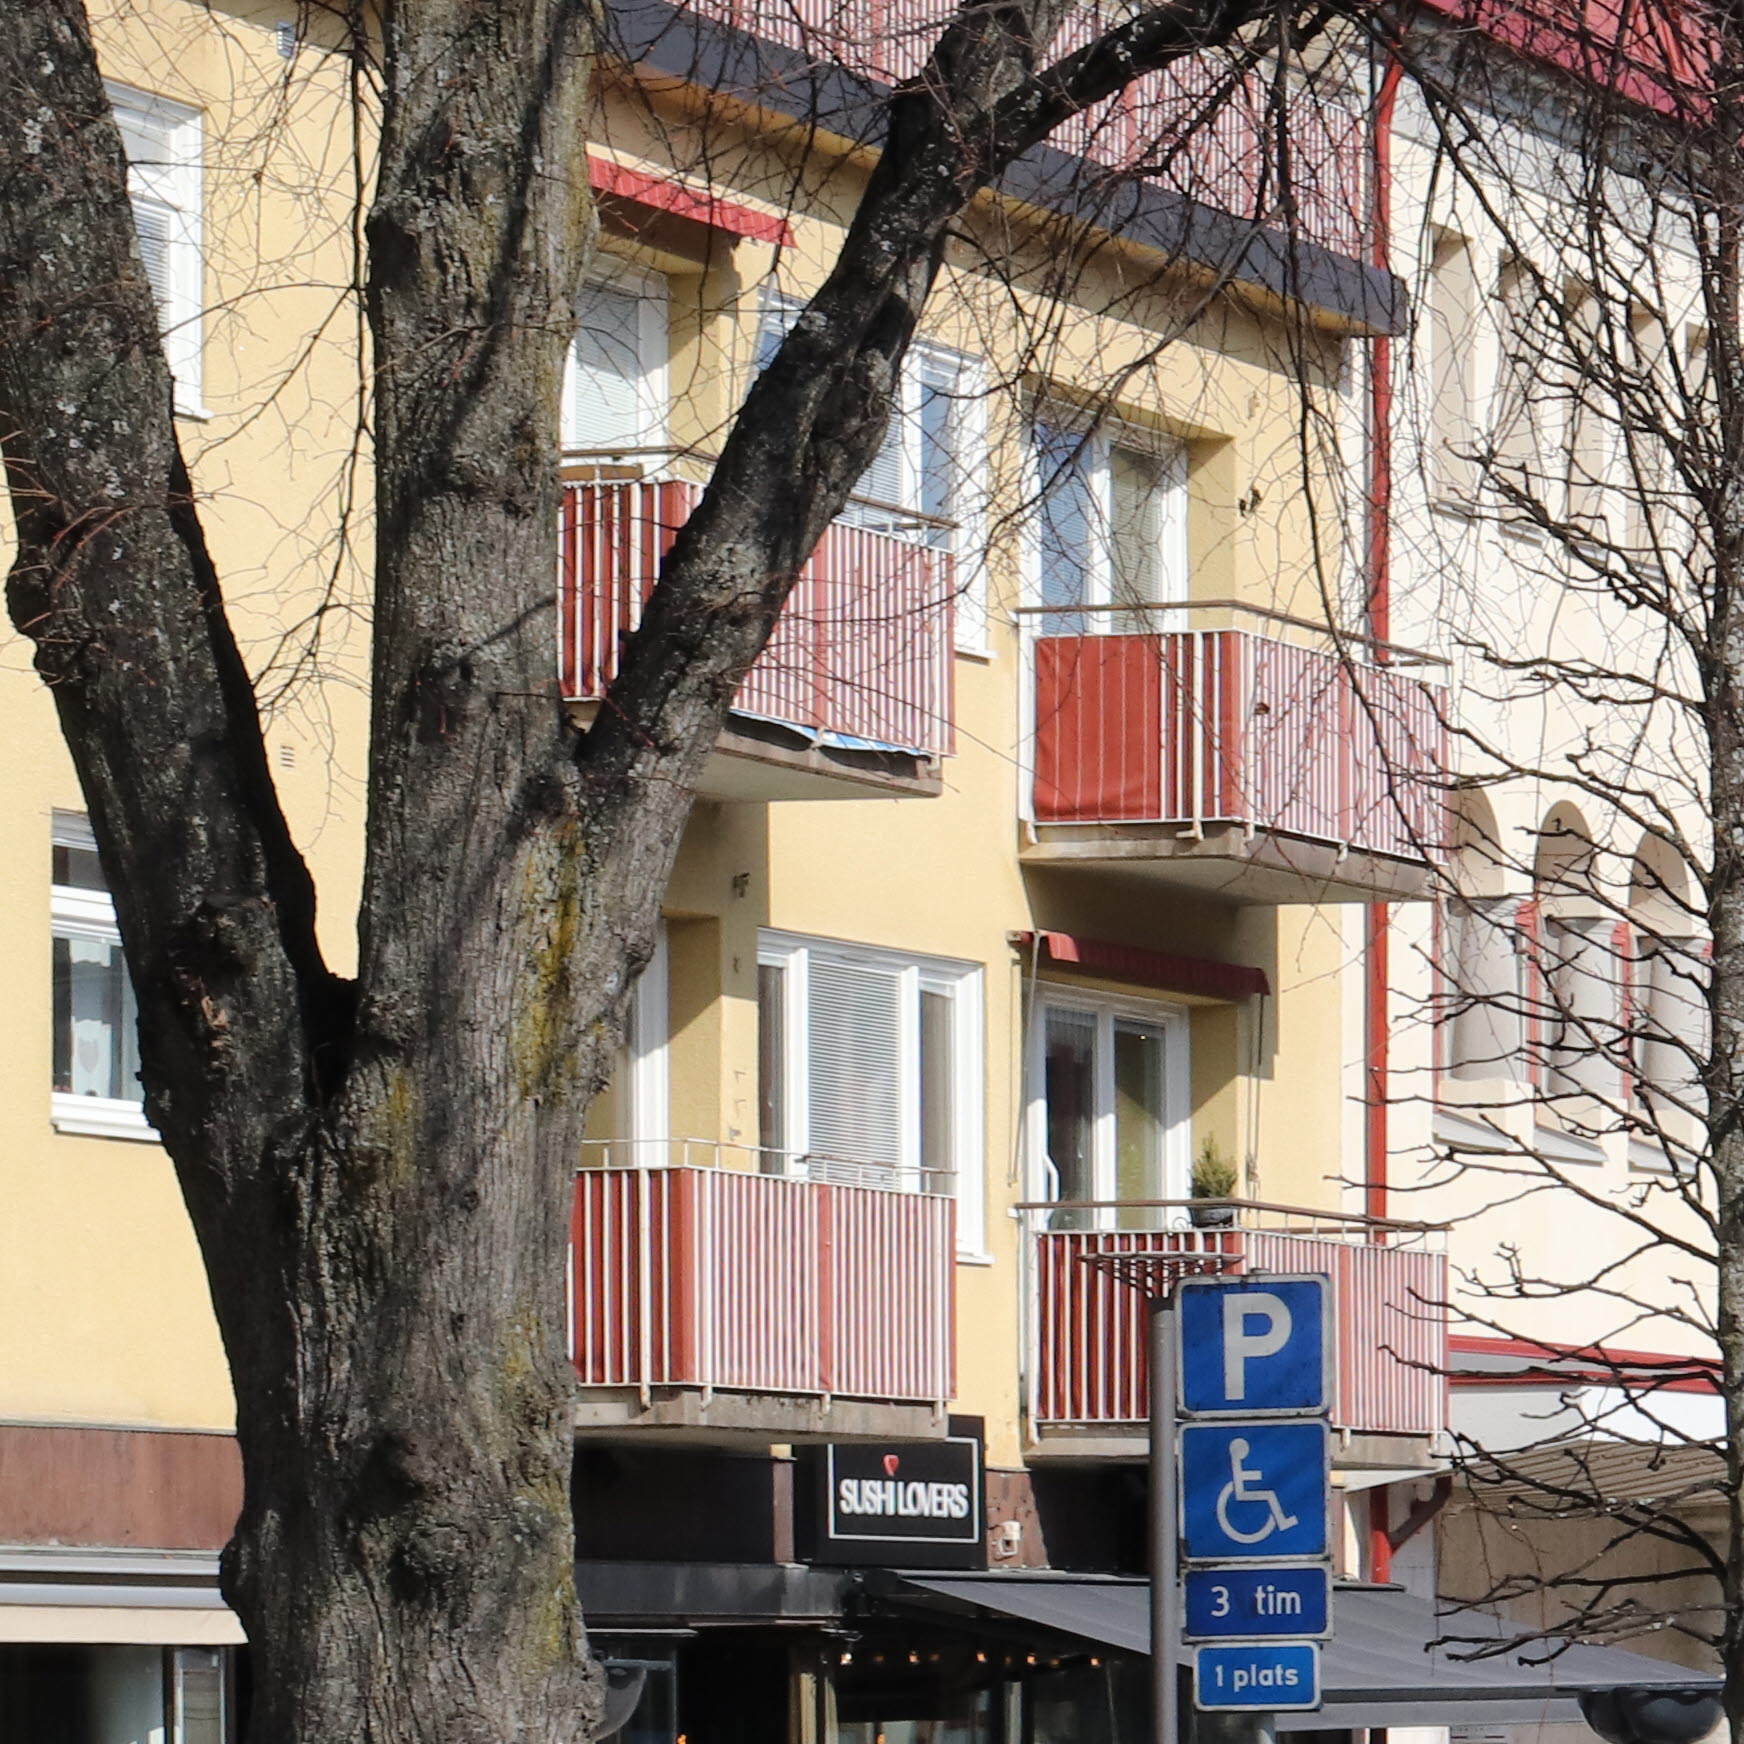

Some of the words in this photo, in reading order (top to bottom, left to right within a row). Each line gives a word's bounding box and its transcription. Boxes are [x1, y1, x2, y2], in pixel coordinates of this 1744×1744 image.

[1223, 1292, 1292, 1400] P
[839, 1478, 895, 1516] SUSHI
[897, 1481, 969, 1519] LOVERS
[1211, 1586, 1230, 1617] 3
[1255, 1585, 1301, 1616] tim
[1215, 1665, 1223, 1687] 1
[1233, 1664, 1299, 1692] plats
